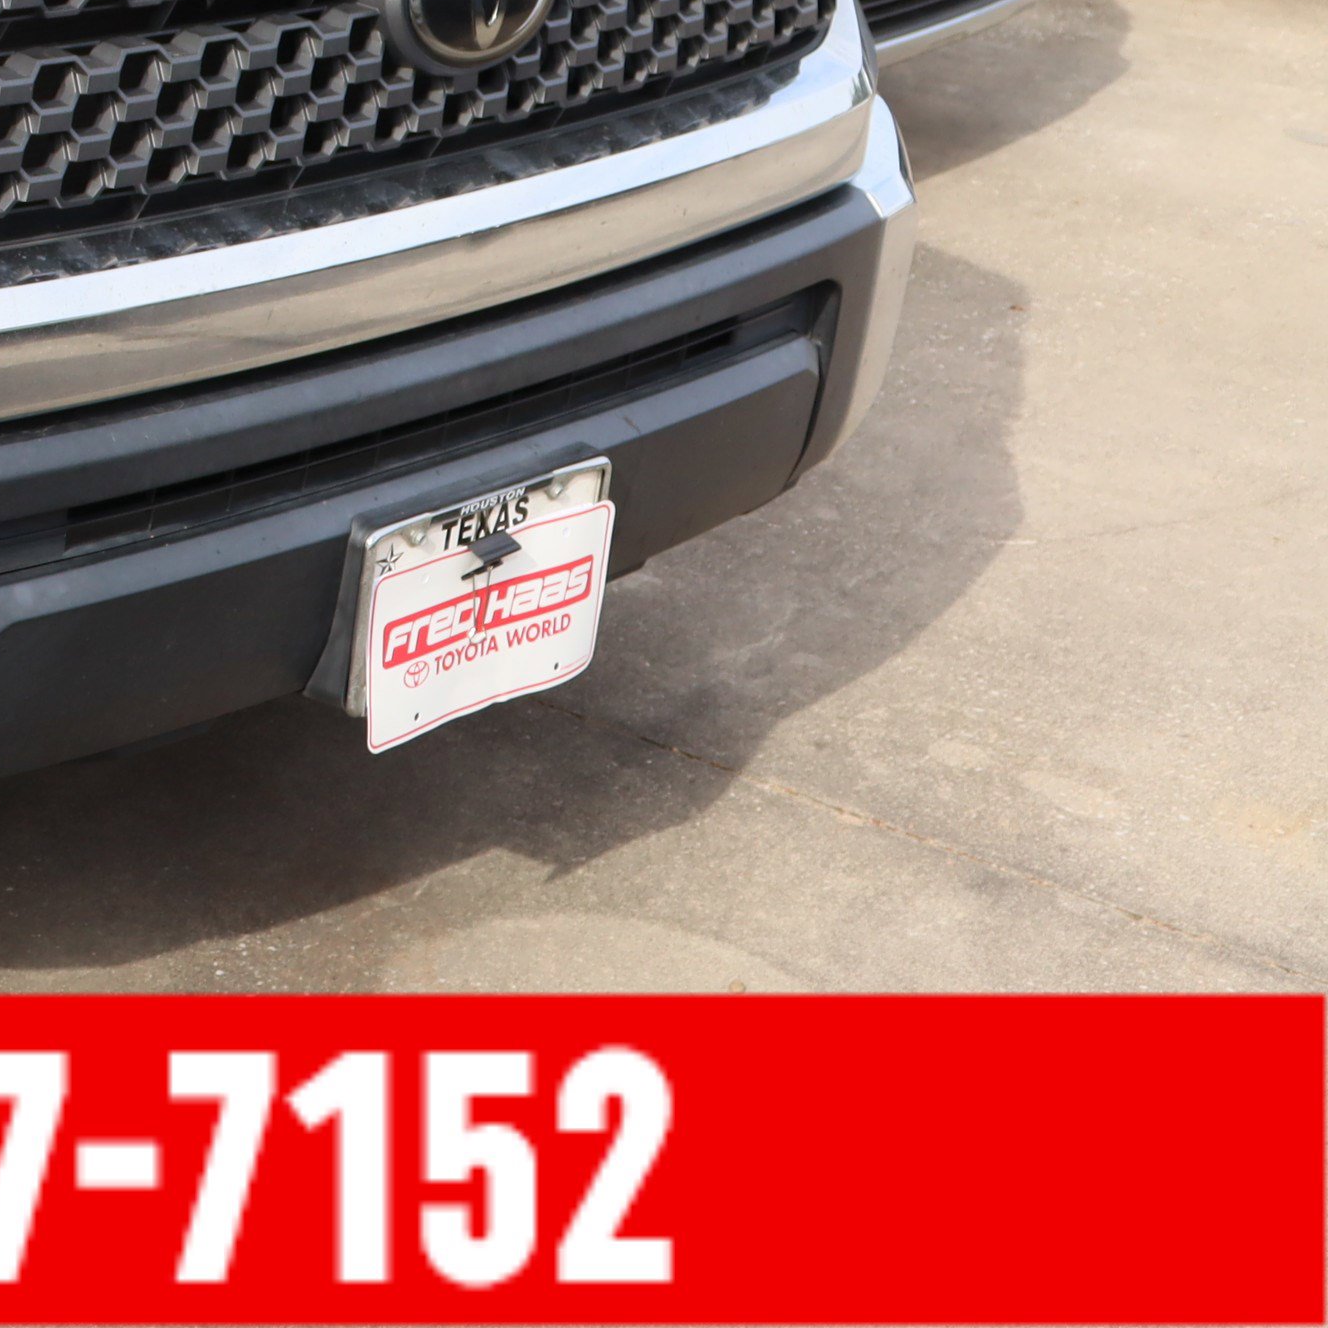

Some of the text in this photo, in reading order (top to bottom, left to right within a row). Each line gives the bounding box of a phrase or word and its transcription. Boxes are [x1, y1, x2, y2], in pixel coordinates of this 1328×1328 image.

[442, 495, 529, 552] TEXAS
[461, 487, 526, 516] HOUSTON
[434, 613, 572, 676] TOYOTA WORLD
